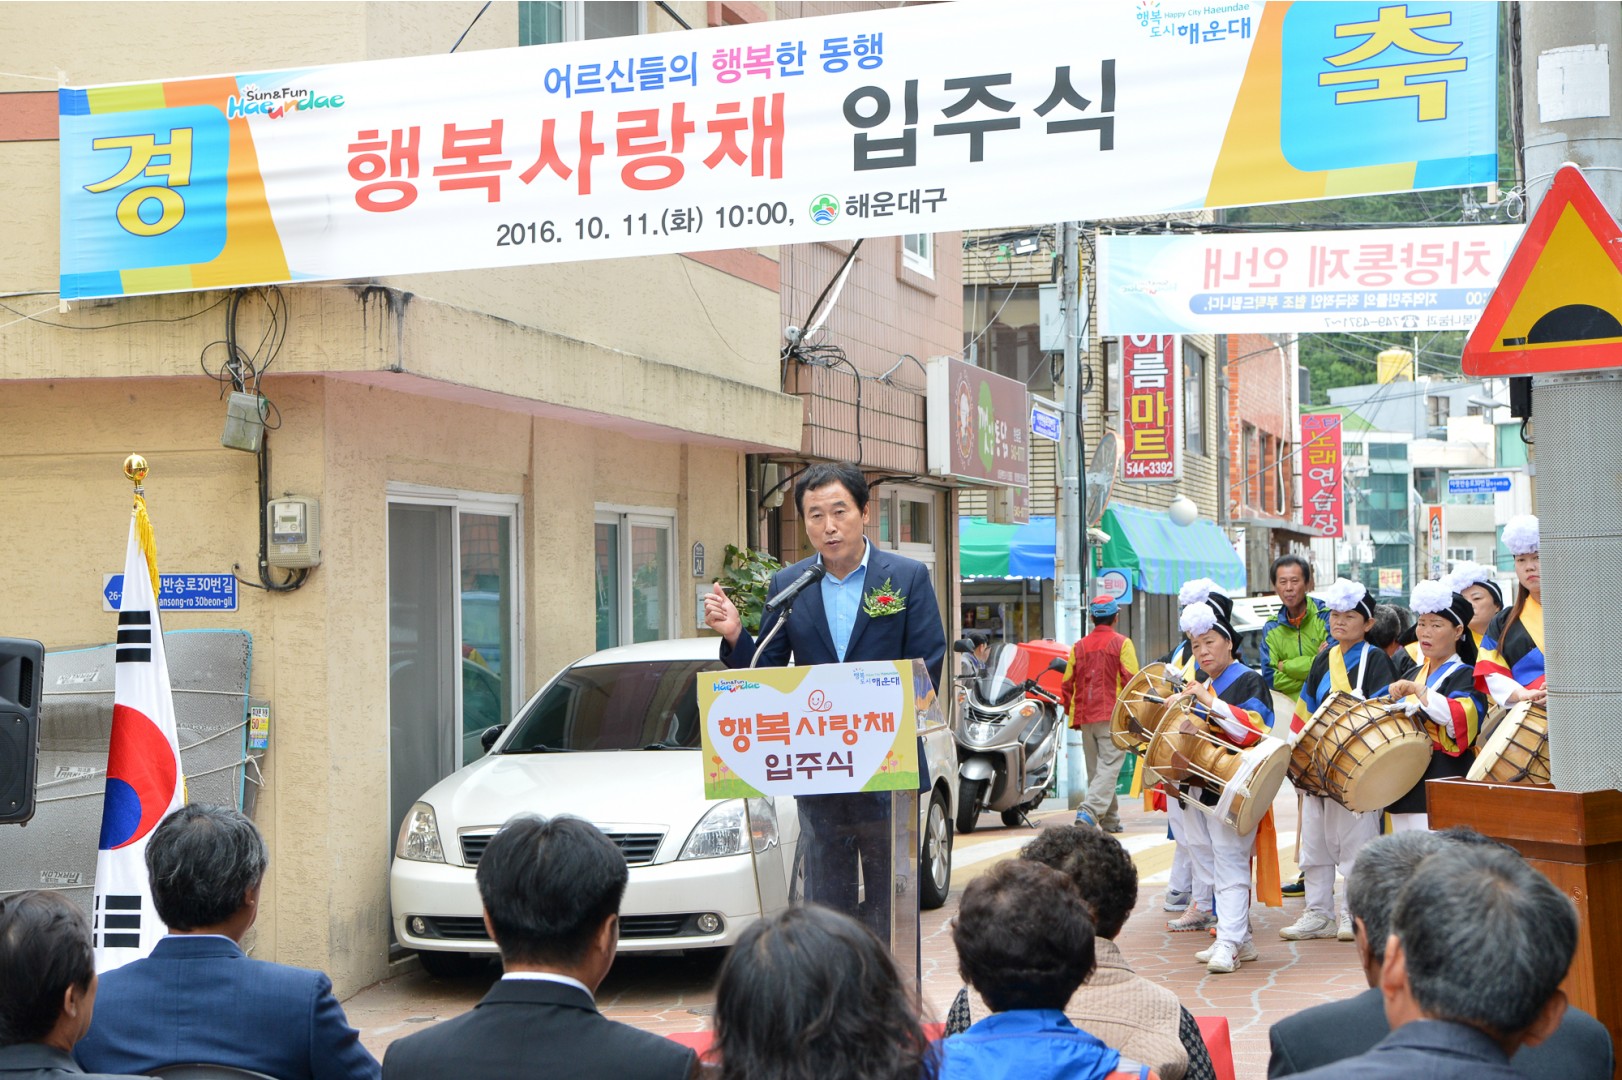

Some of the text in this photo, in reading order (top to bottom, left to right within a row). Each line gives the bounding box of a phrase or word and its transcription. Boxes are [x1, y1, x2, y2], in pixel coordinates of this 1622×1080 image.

[1136, 9, 1162, 27] 행복
[1164, 2, 1250, 19] Happy City Haeundae
[1149, 16, 1251, 45] 도시 해운대
[543, 32, 884, 99] 어르신들의 행복한 동행
[1317, 3, 1469, 122] 축
[227, 90, 346, 120] Haeundae
[246, 87, 308, 102] Sun&Fun
[346, 58, 1116, 214] 행복사랑채 입주식
[83, 127, 194, 237] 경
[845, 187, 948, 219] 해운대구
[496, 201, 796, 247] 2016. 10. 11.(화) 10:00,
[1126, 462, 1174, 475] 544-3392
[1308, 430, 1338, 536] 노래연습장
[158, 576, 233, 594] 반송로30번길
[159, 596, 233, 608] ansong-ro 30beon-gil
[717, 711, 895, 753] 행복사랑채
[765, 750, 854, 782] 입주식
